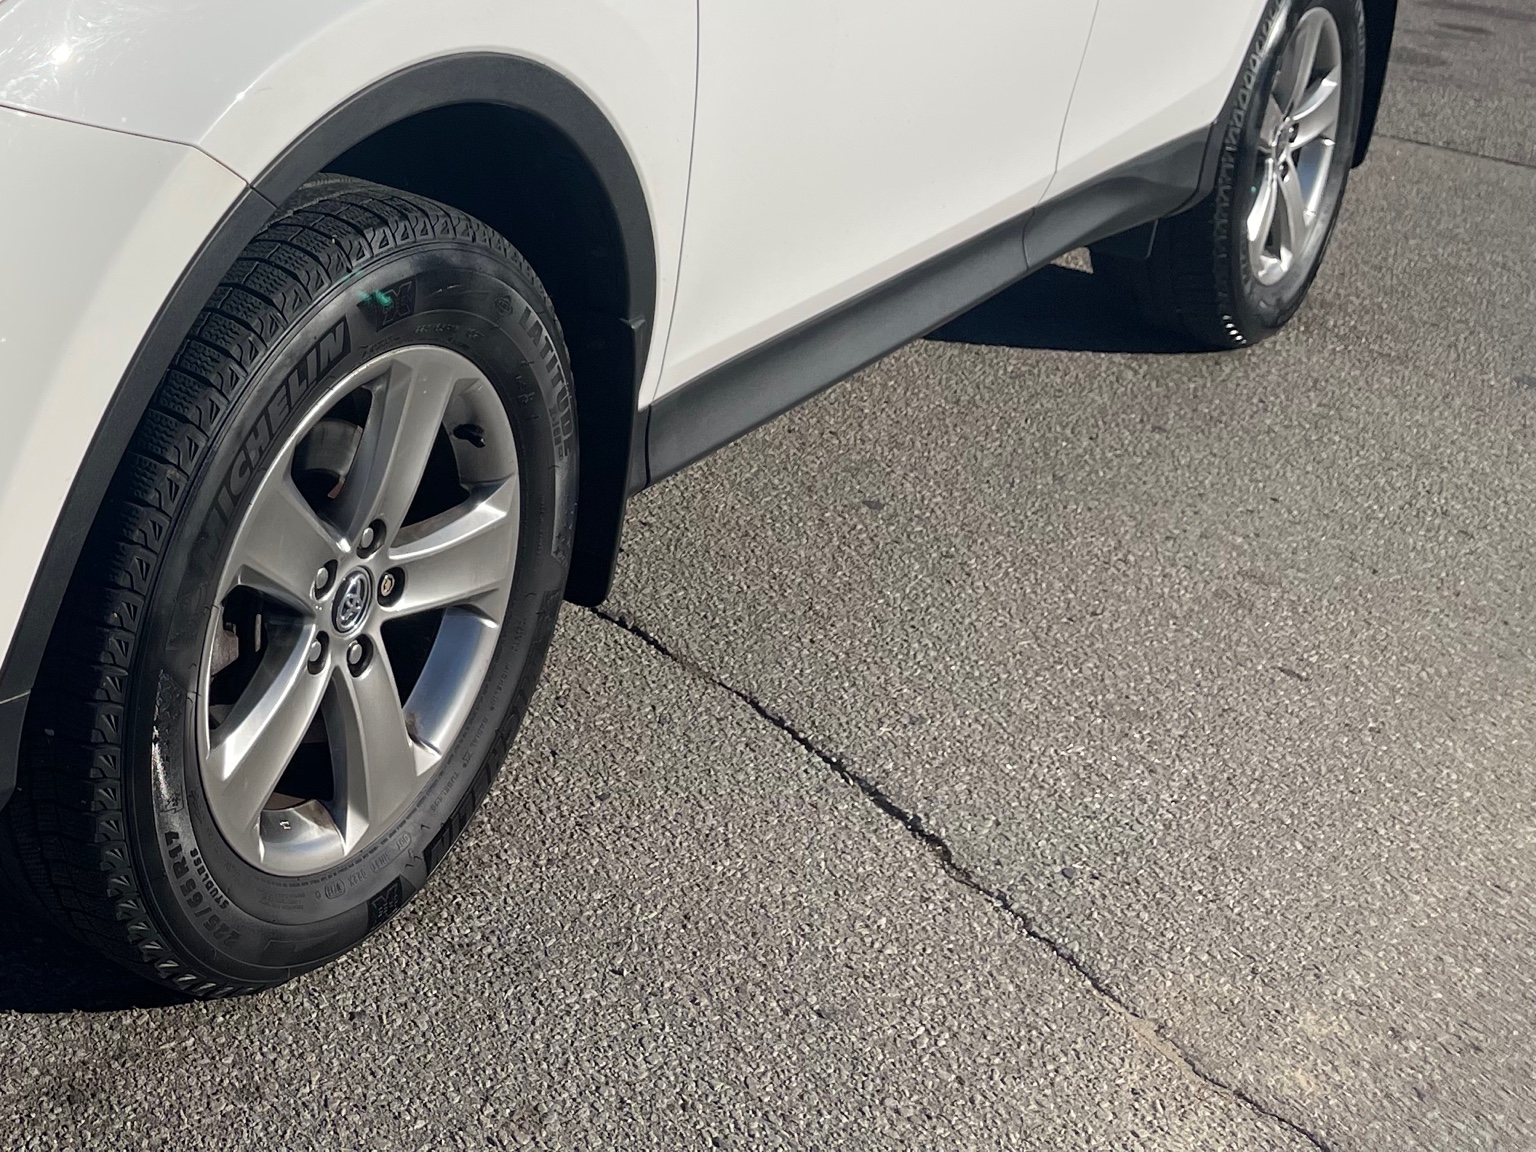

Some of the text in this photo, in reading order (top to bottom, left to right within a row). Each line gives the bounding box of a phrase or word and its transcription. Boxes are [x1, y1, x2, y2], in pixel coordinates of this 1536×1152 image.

[518, 308, 574, 457] LATITUDE
[164, 831, 241, 946] 225/65 R17
[190, 848, 230, 910] STUDLESS
